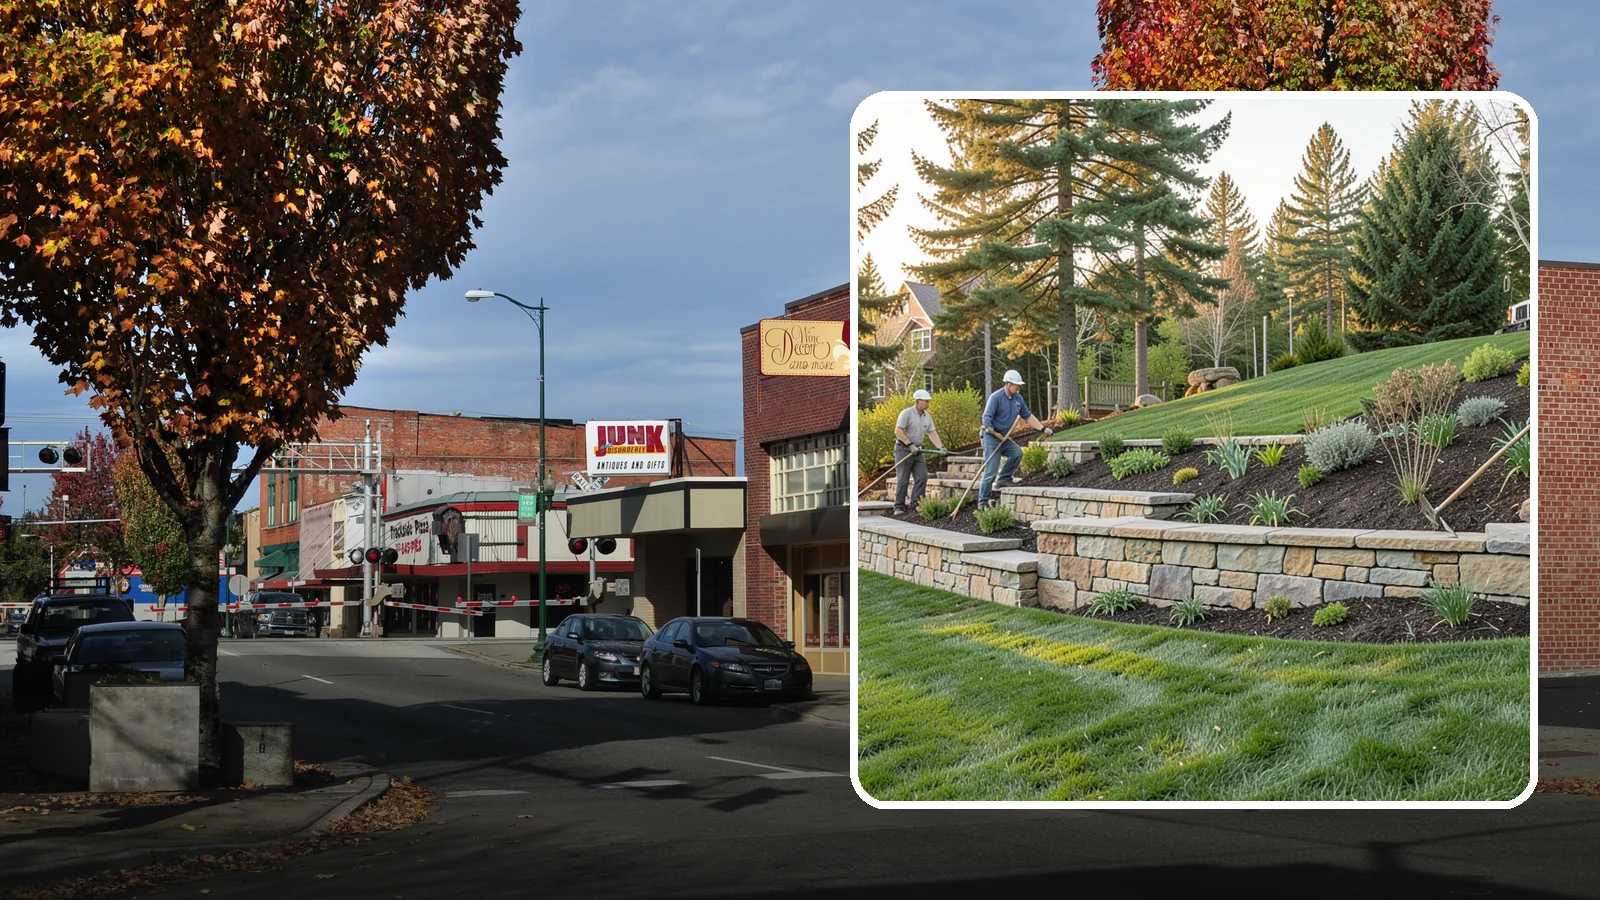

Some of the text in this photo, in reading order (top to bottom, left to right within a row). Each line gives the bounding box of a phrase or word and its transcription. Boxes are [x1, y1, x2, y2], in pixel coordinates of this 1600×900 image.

[595, 425, 665, 457] JUNK
[607, 446, 645, 454] DISORDERLY
[597, 460, 665, 470] ANTIQUES AND GIFTS
[390, 519, 429, 540] Trackside Pizza
